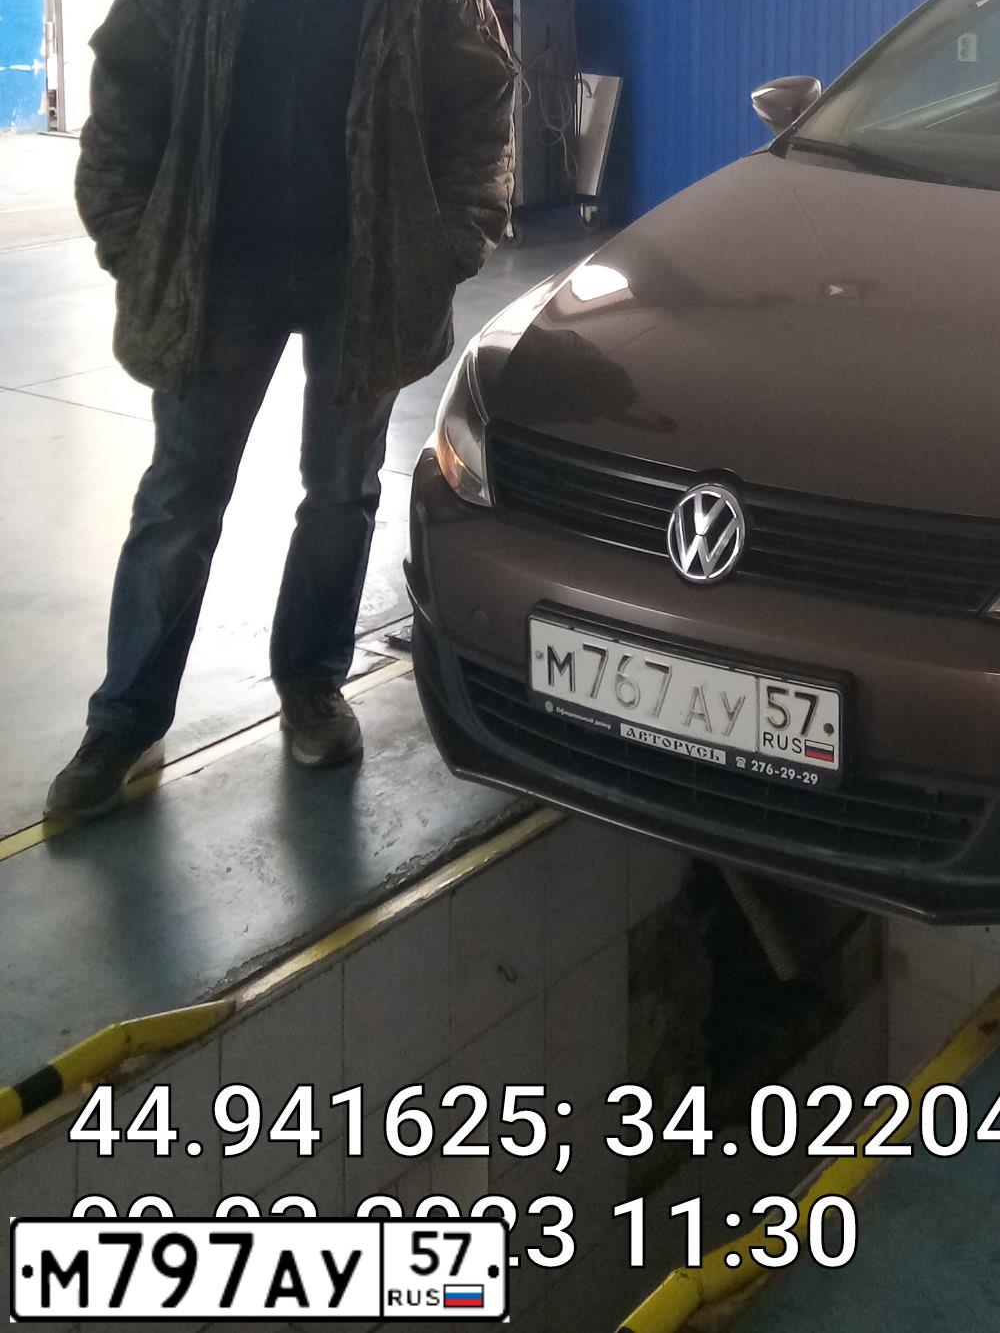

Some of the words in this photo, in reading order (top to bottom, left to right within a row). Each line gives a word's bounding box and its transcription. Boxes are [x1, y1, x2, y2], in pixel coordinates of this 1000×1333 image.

[764, 685, 820, 738] 57
[762, 731, 803, 754] RUS
[751, 759, 819, 785] 276-29-29
